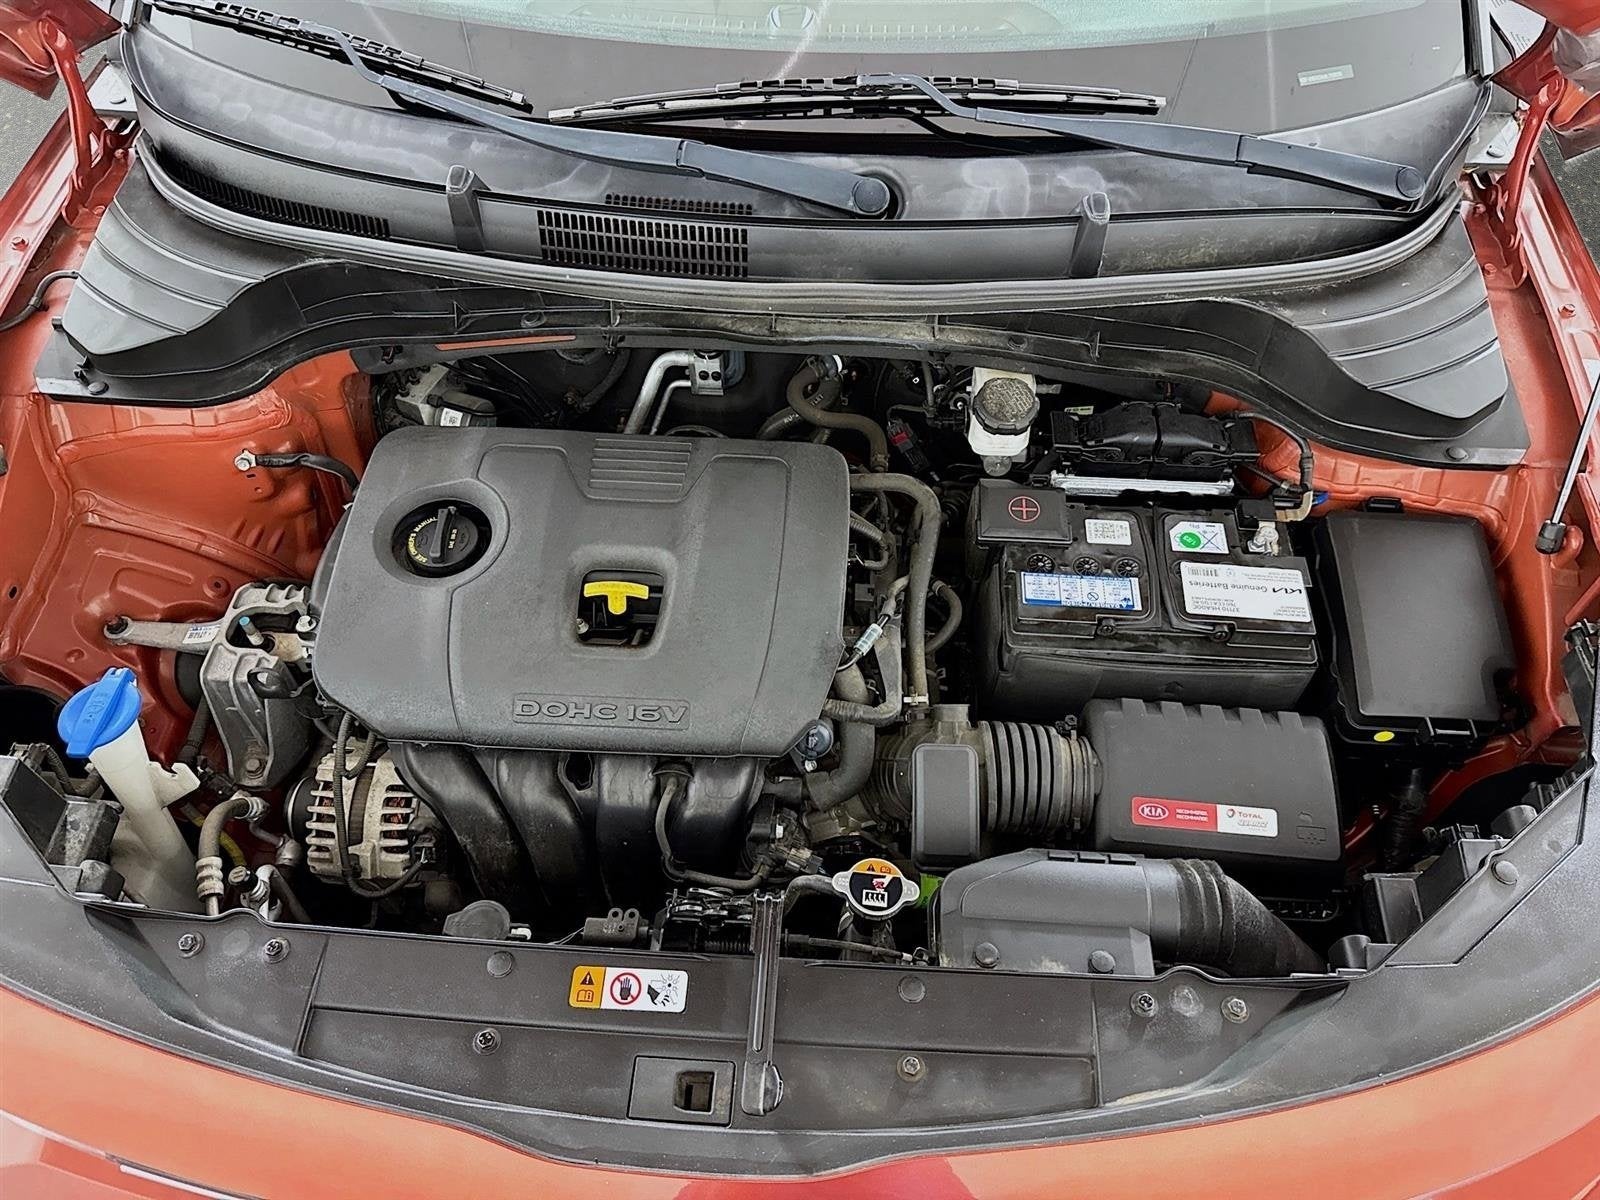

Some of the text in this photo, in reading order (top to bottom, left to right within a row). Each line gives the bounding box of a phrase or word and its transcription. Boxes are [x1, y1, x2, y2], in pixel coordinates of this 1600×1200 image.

[1188, 579, 1303, 595] KIA Genuine Batteries
[515, 699, 688, 724] DOHC 16V
[1143, 806, 1165, 817] KIA
[1238, 811, 1263, 820] TOTAL
